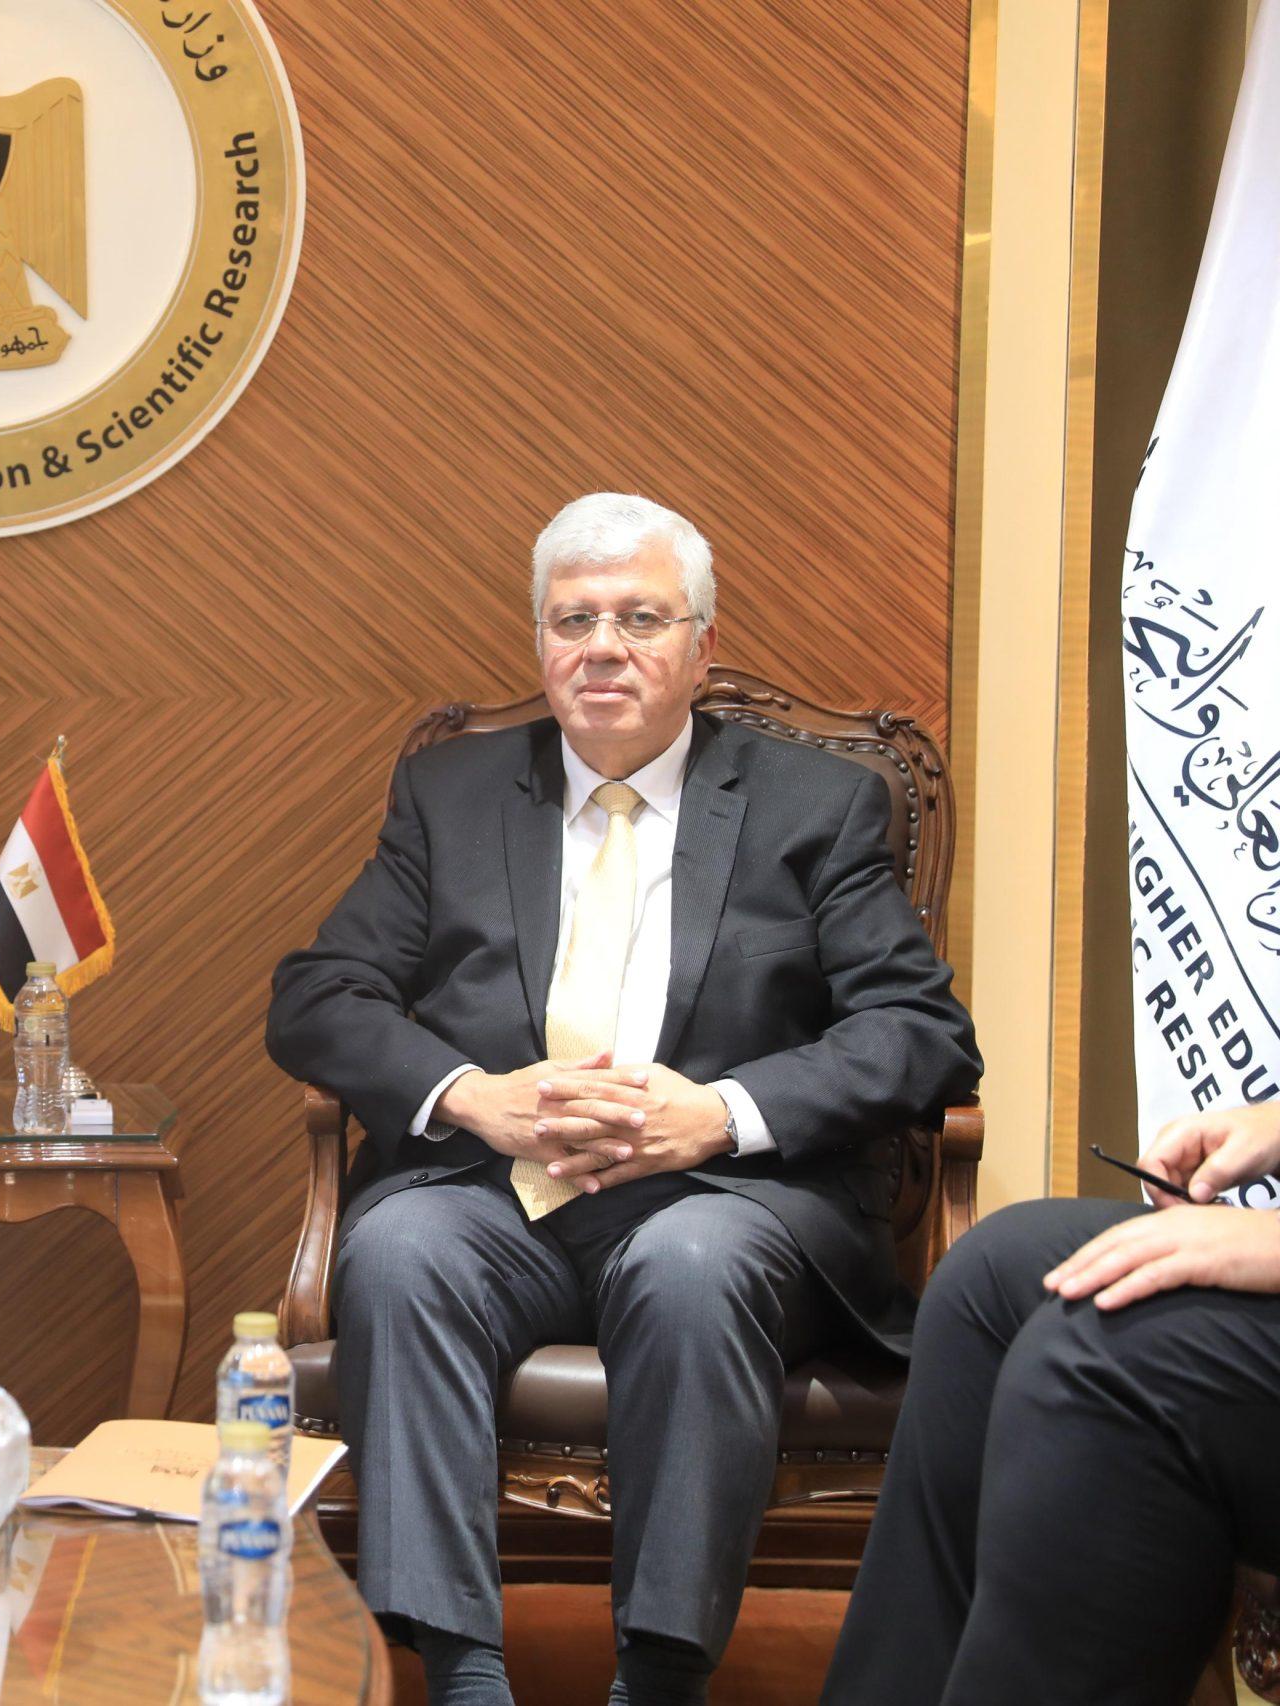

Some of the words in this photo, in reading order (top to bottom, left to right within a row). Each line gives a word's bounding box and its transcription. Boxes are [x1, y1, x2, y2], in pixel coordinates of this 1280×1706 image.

[159, 0, 228, 81] وزار
[41, 445, 73, 478] &
[76, 321, 224, 464] Scientific
[203, 131, 260, 318] Research
[1128, 820, 1215, 997] IGHER
[1207, 998, 1280, 1105] EDU
